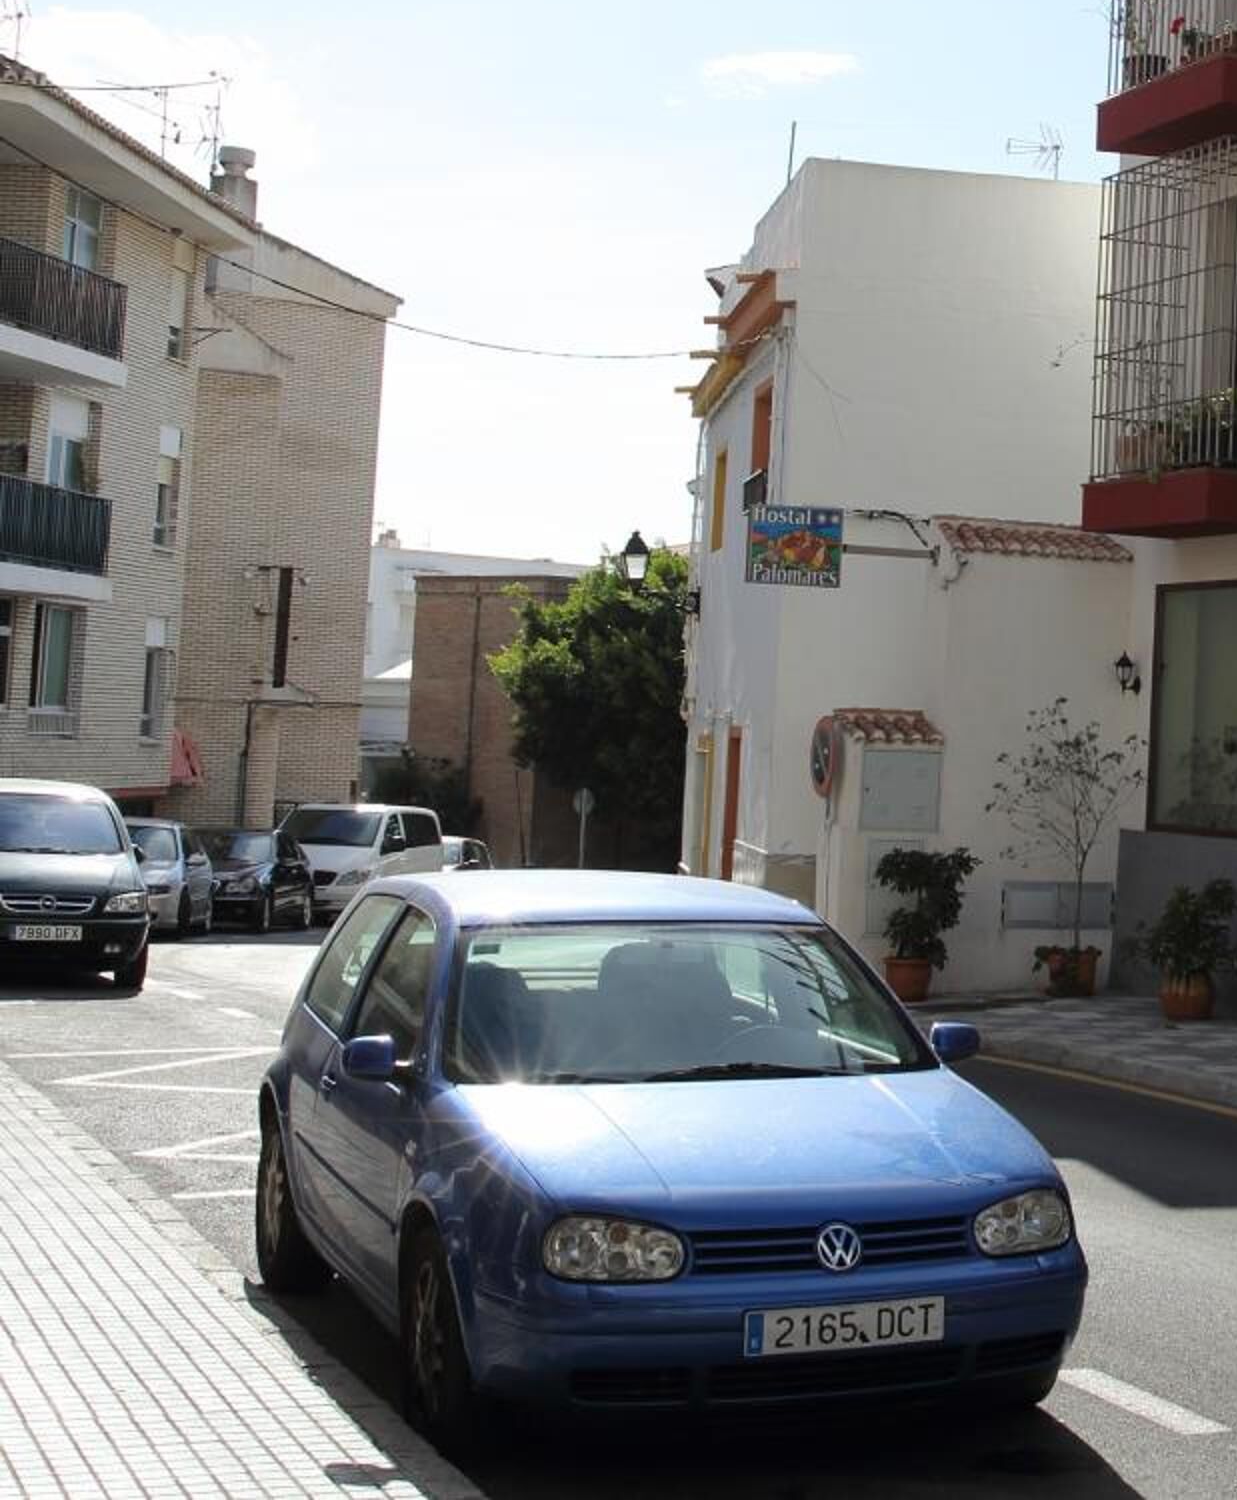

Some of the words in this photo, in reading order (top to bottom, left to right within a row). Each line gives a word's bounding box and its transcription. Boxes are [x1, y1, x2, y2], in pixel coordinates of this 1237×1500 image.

[752, 508, 812, 525] Hostal
[752, 563, 838, 586] Palomares
[17, 927, 52, 939] 7990
[55, 928, 79, 939] DFX
[775, 1311, 858, 1349] 2165
[876, 1304, 936, 1340] DCT
